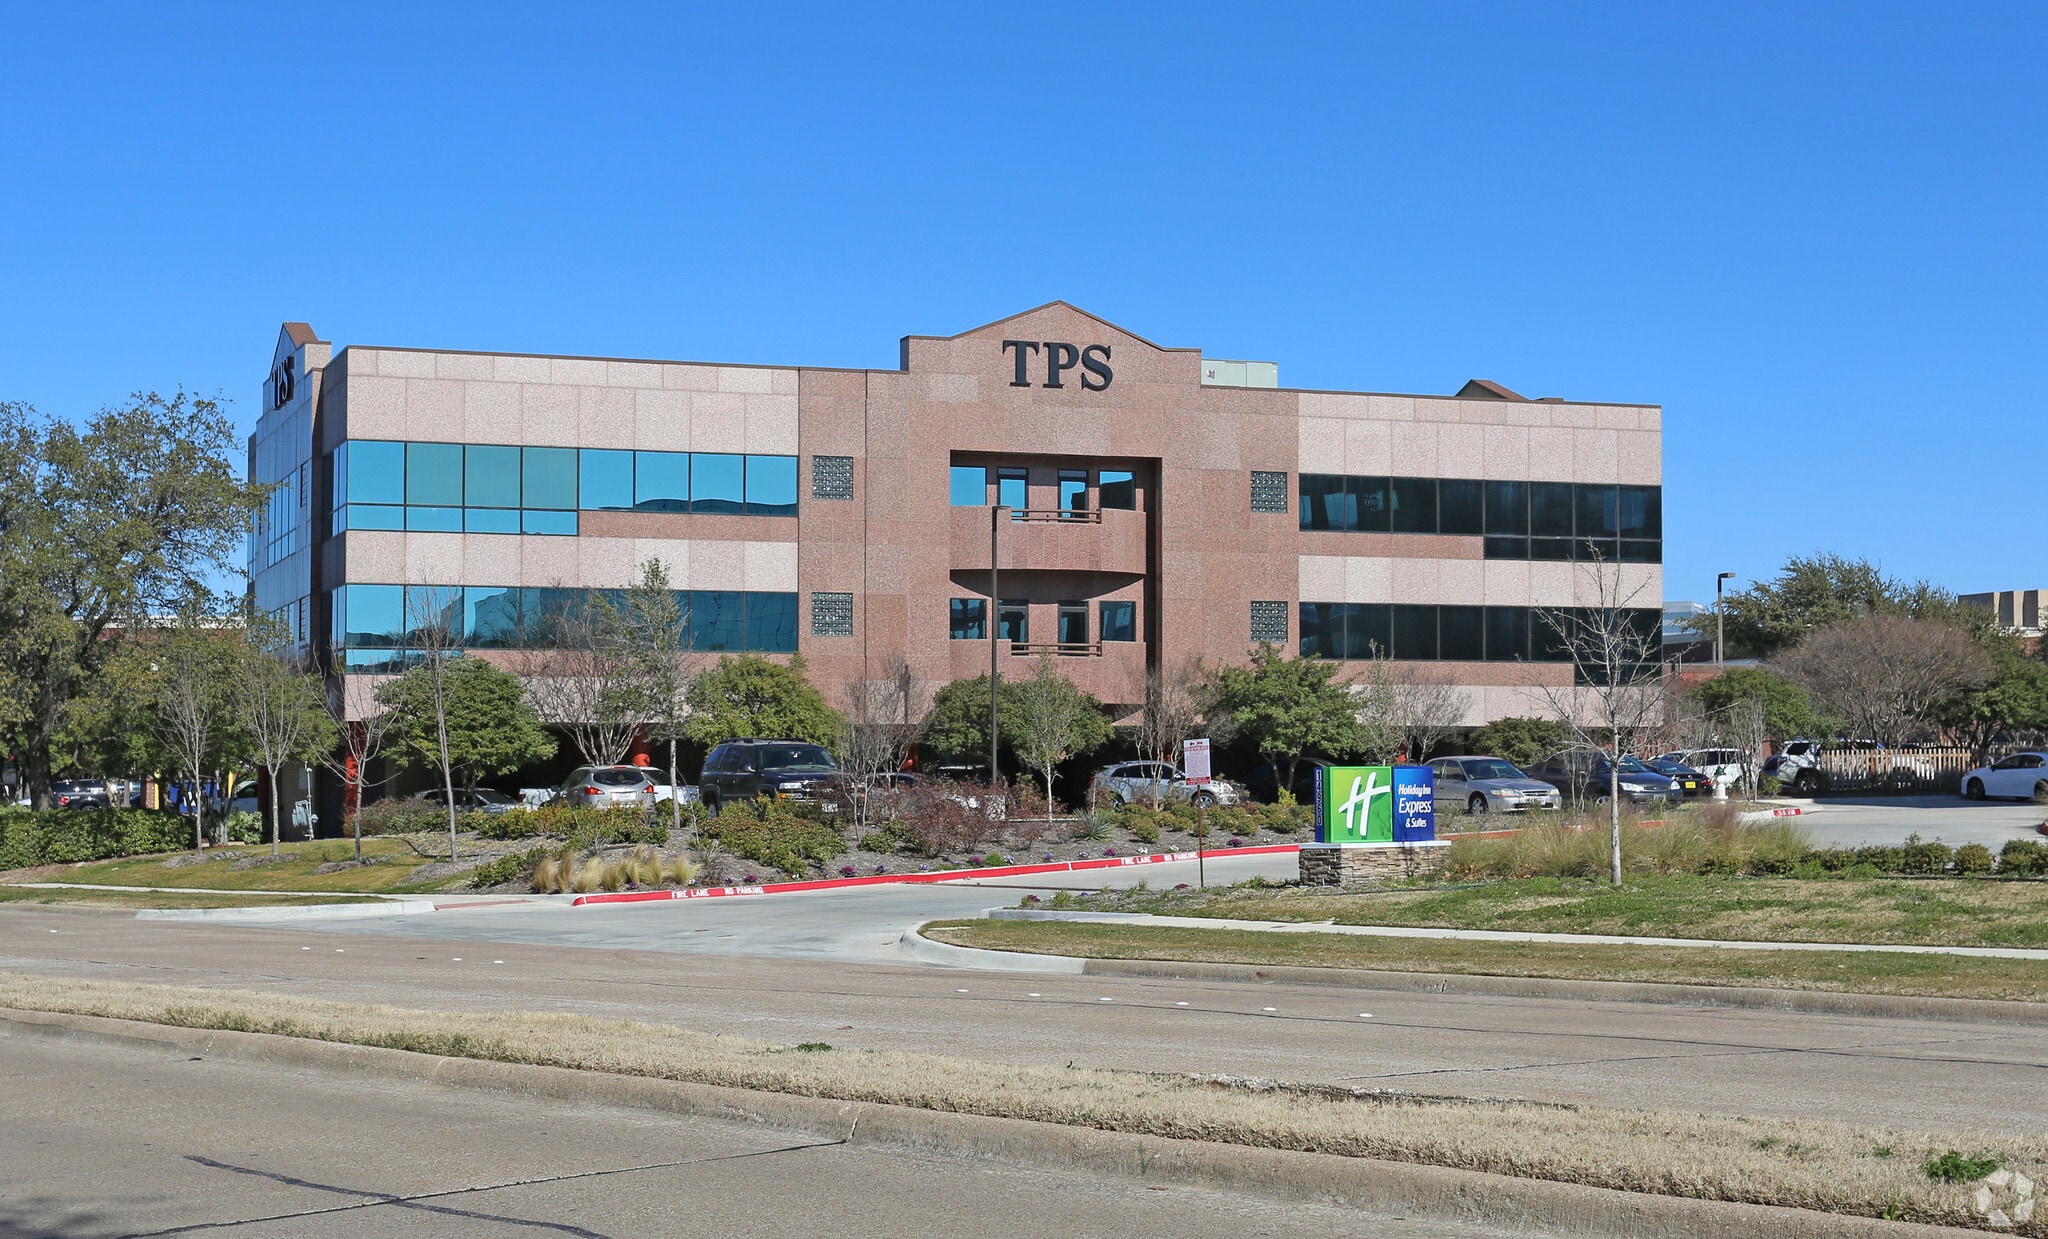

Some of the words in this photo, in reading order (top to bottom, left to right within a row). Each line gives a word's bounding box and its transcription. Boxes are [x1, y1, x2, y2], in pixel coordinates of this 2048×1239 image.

[1002, 340, 1113, 392] TPS
[1398, 783, 1422, 798] Holiday
[1422, 783, 1432, 795] Inn
[1398, 797, 1432, 817] Express
[1405, 817, 1411, 828] &
[1411, 817, 1427, 828] Suites
[671, 890, 688, 899] FIRE
[690, 888, 710, 897] LANE
[724, 887, 735, 895] NO
[736, 886, 764, 895] PARKING
